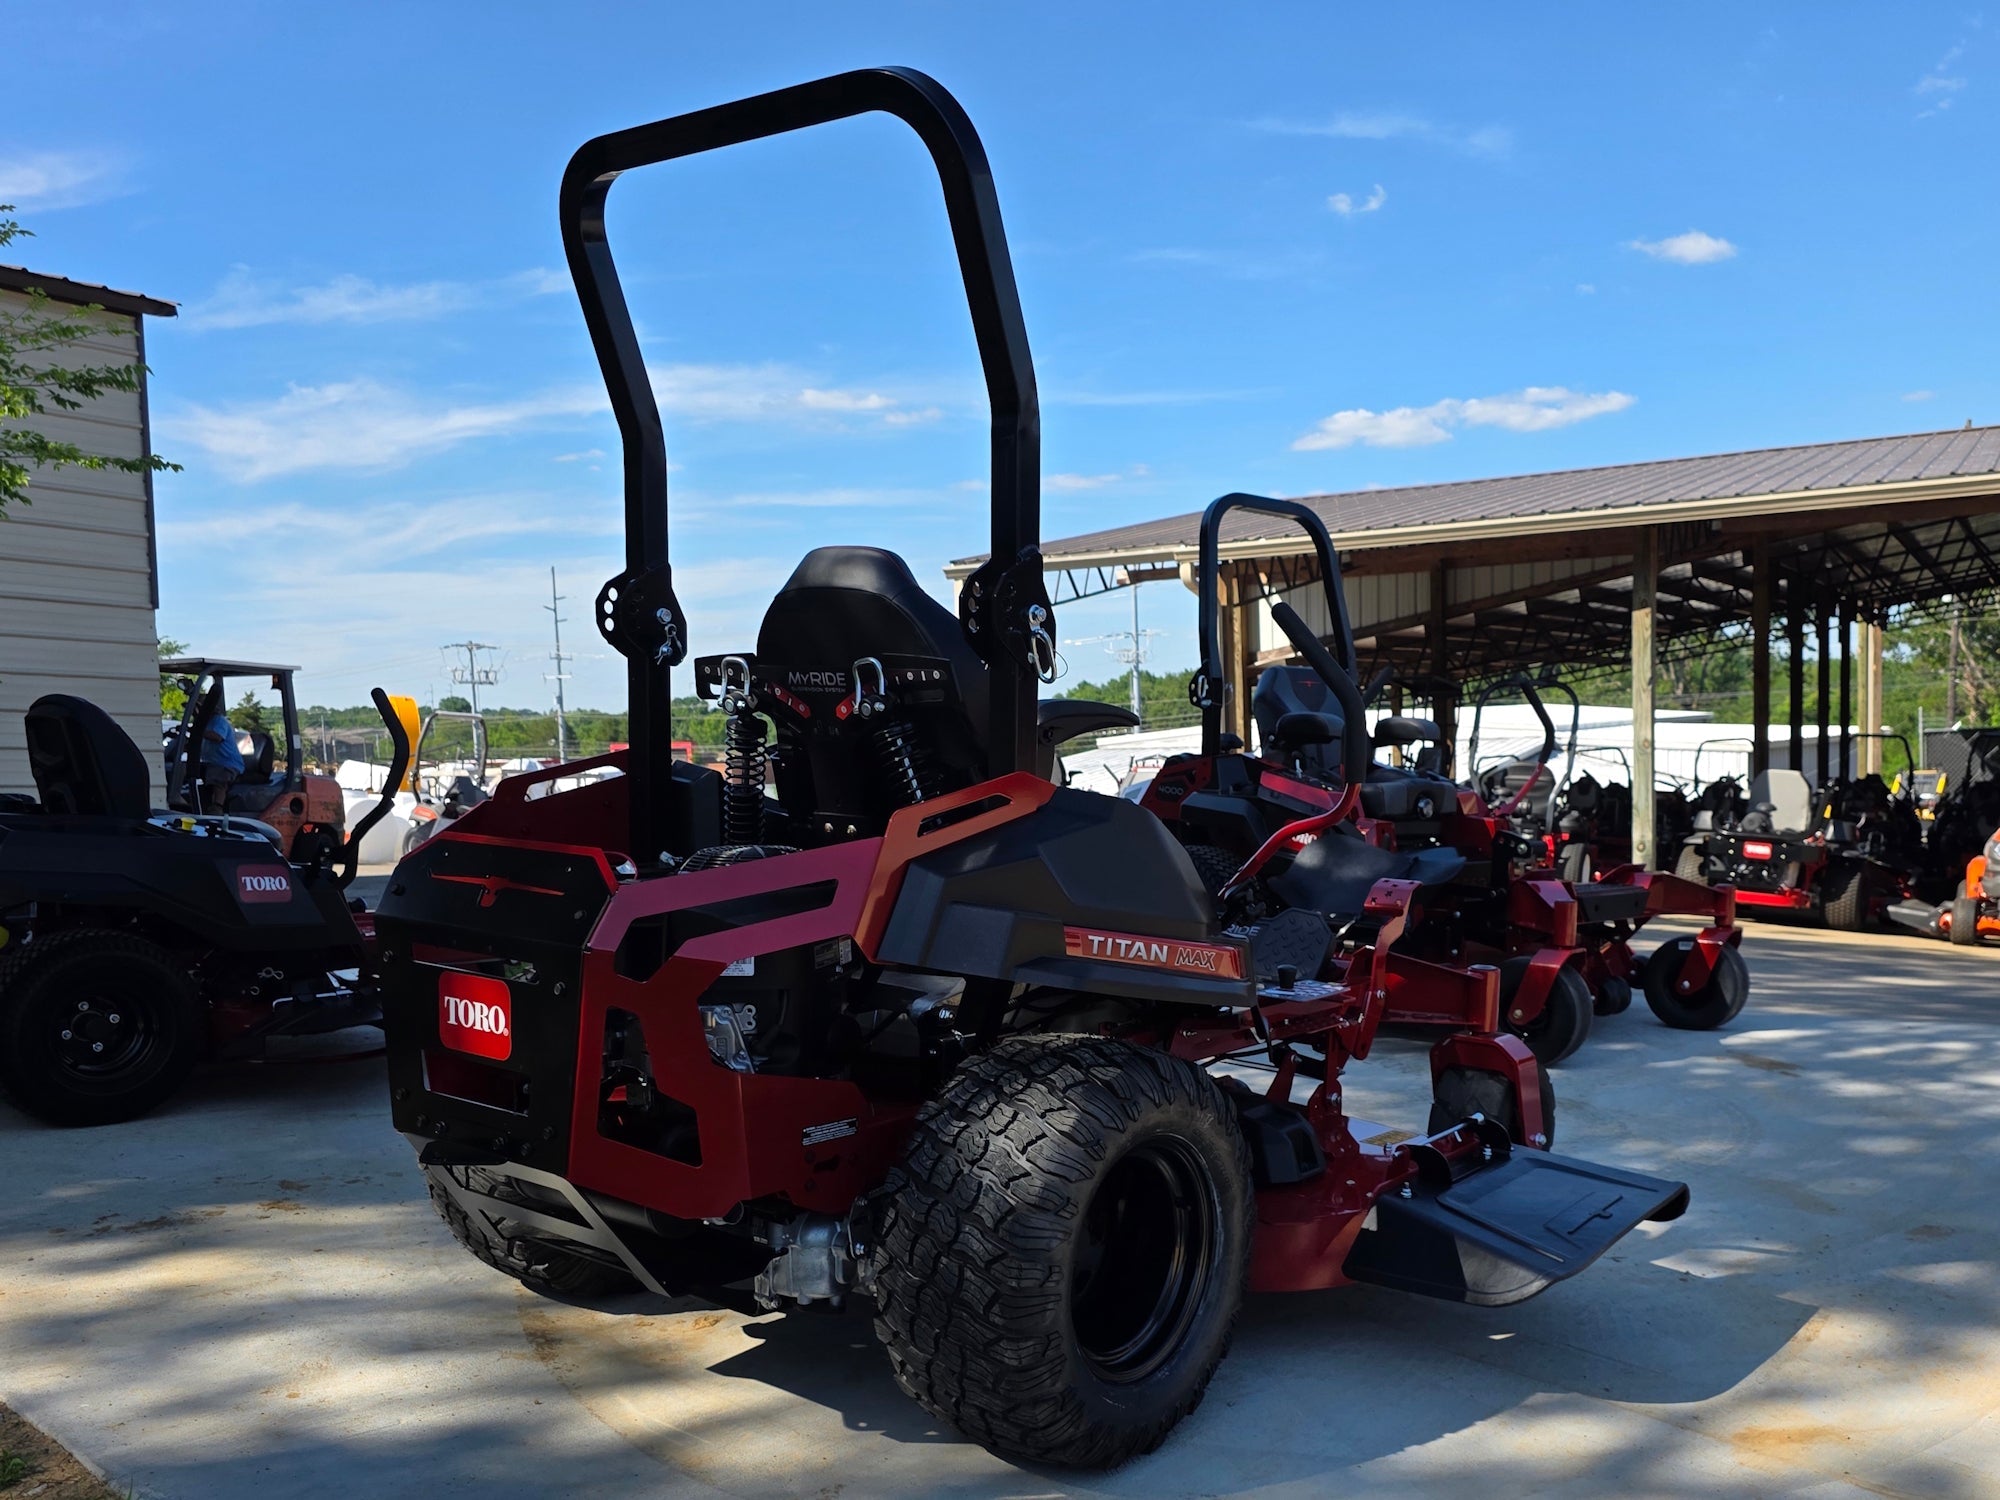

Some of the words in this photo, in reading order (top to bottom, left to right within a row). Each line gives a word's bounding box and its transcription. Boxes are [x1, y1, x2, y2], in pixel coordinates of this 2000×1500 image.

[788, 671, 847, 687] MyRIDE
[1158, 784, 1185, 796] 4000
[241, 875, 288, 892] TORO
[1088, 935, 1169, 963] TITAN
[1174, 947, 1216, 972] MAX
[444, 995, 507, 1035] TORO
